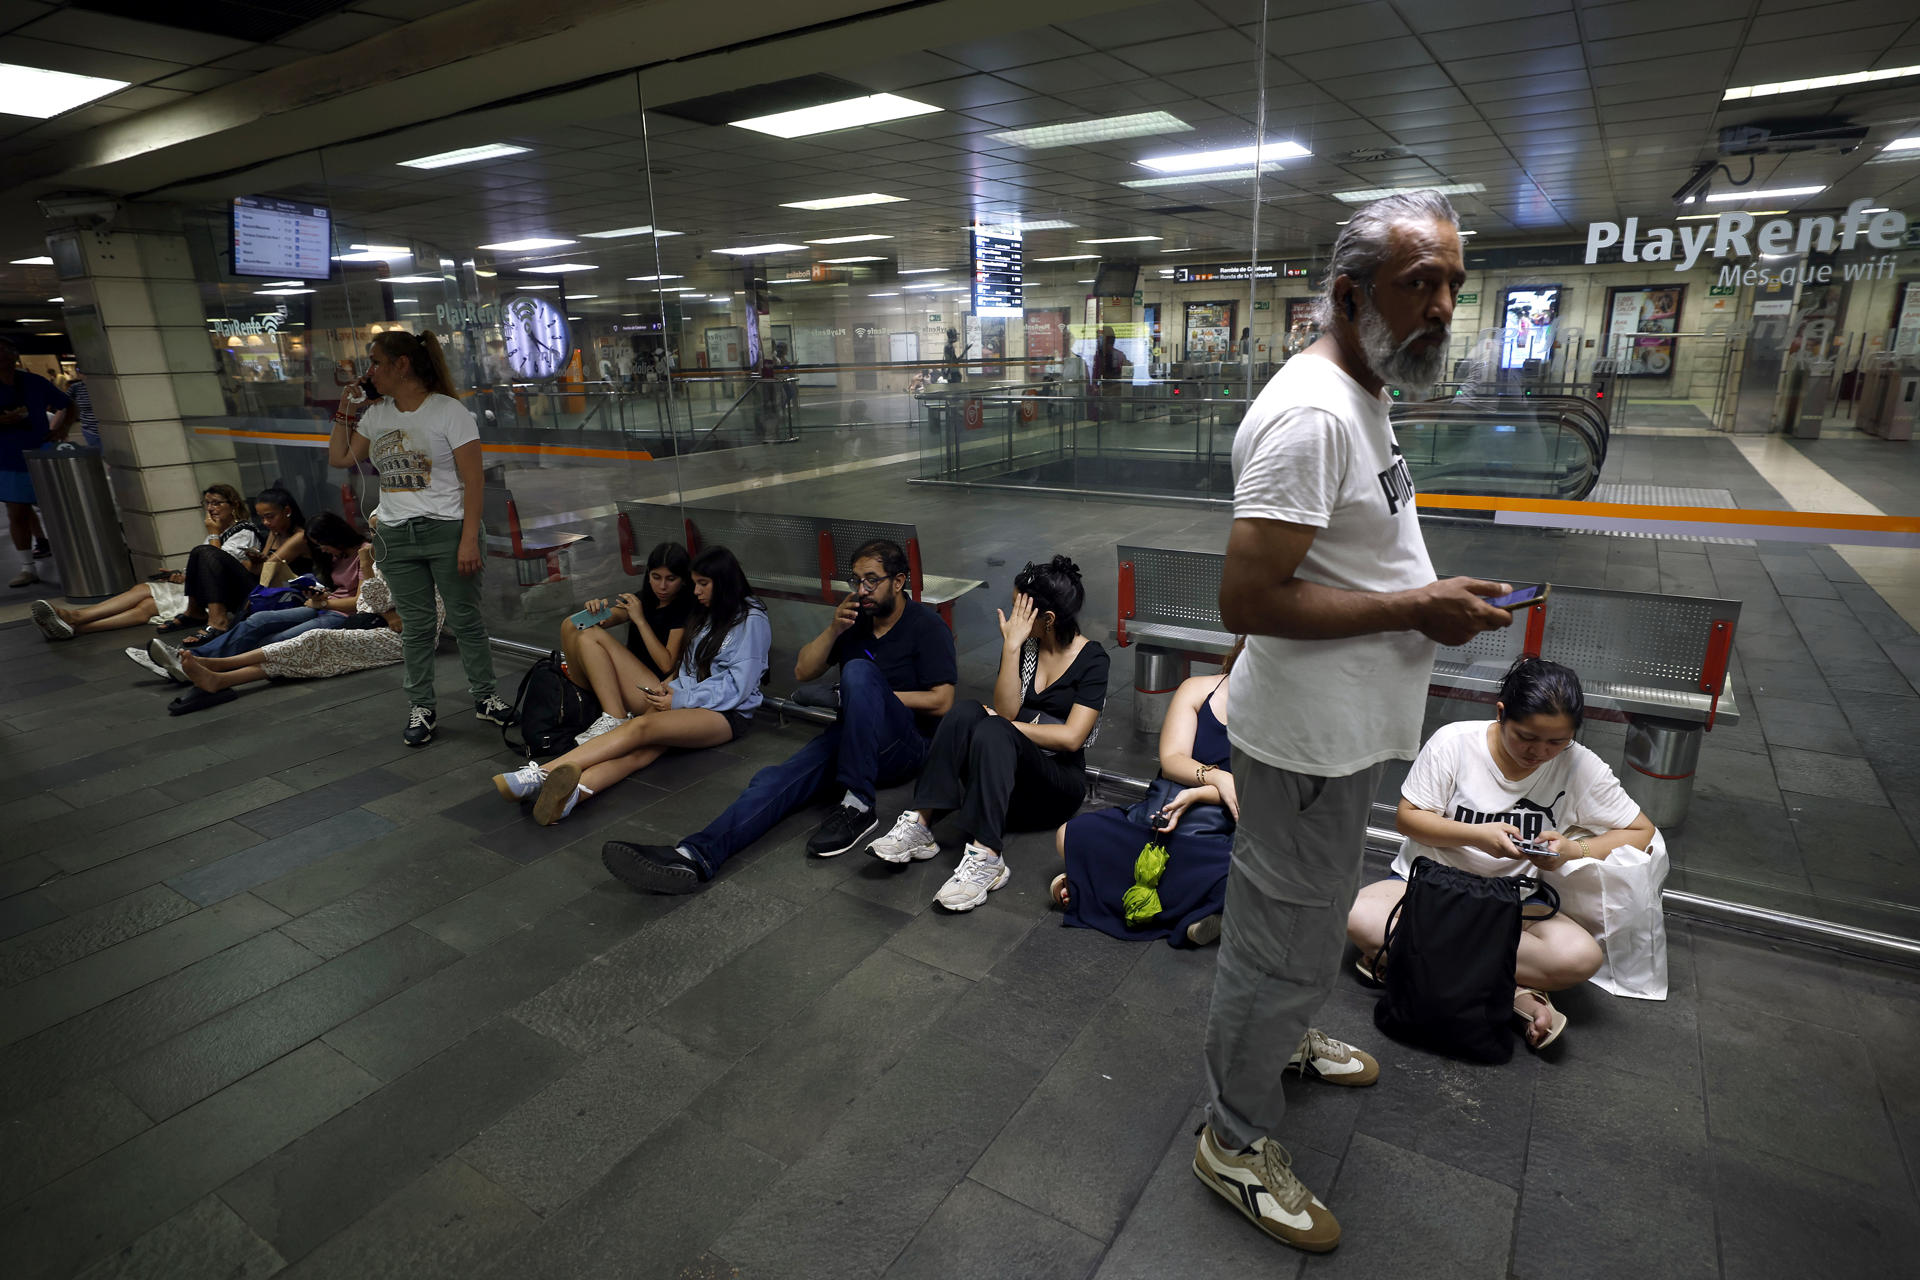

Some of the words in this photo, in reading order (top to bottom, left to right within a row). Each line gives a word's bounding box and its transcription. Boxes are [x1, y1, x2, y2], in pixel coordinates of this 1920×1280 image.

[1584, 197, 1907, 272] PlayRenfe
[1717, 261, 1771, 287] Més
[1779, 263, 1832, 289] que
[1844, 255, 1898, 281] wifi
